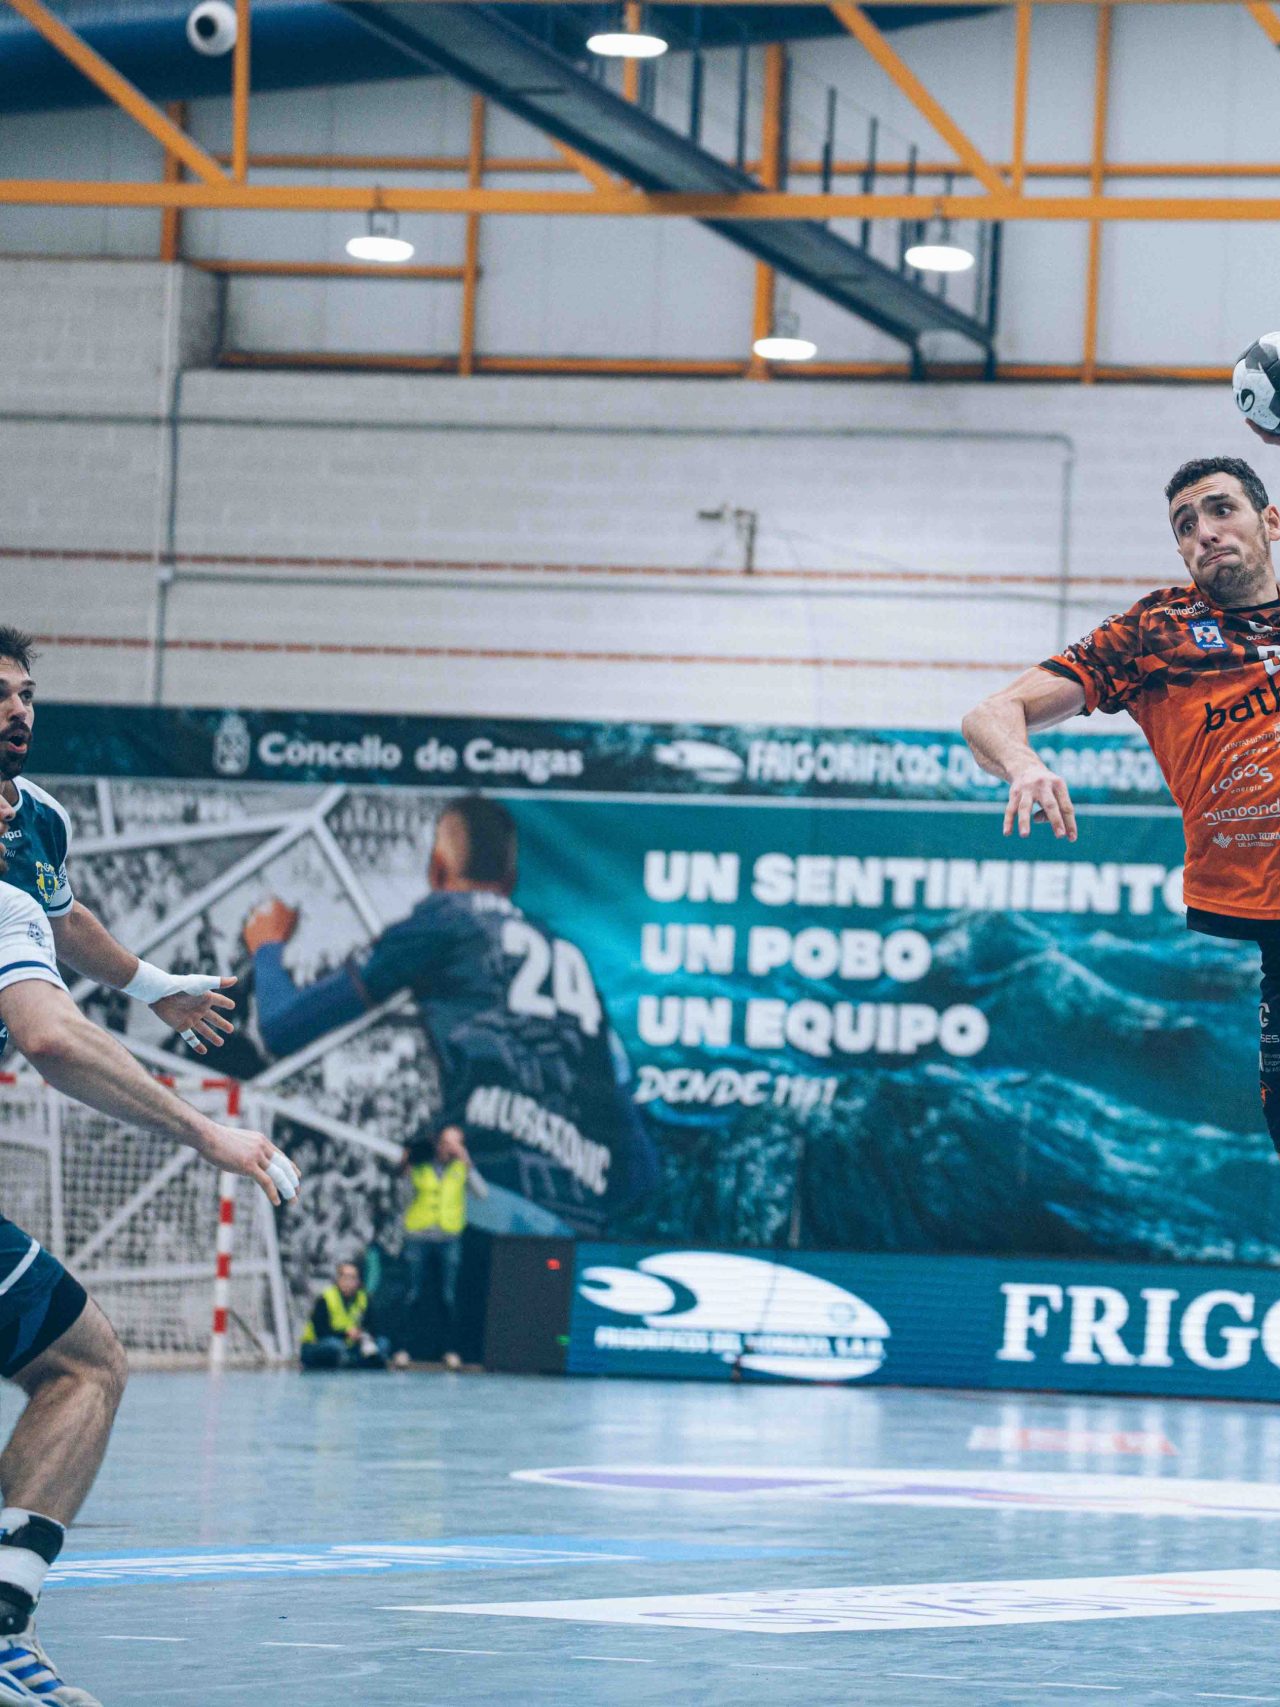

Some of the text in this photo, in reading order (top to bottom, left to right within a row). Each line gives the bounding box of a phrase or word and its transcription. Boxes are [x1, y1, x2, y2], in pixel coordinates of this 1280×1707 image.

[258, 731, 584, 784] Concello de Cangas
[643, 850, 740, 903] UN
[502, 918, 604, 1038] 24
[640, 923, 932, 983] UN POBO
[637, 995, 990, 1058] UN EQUIPO
